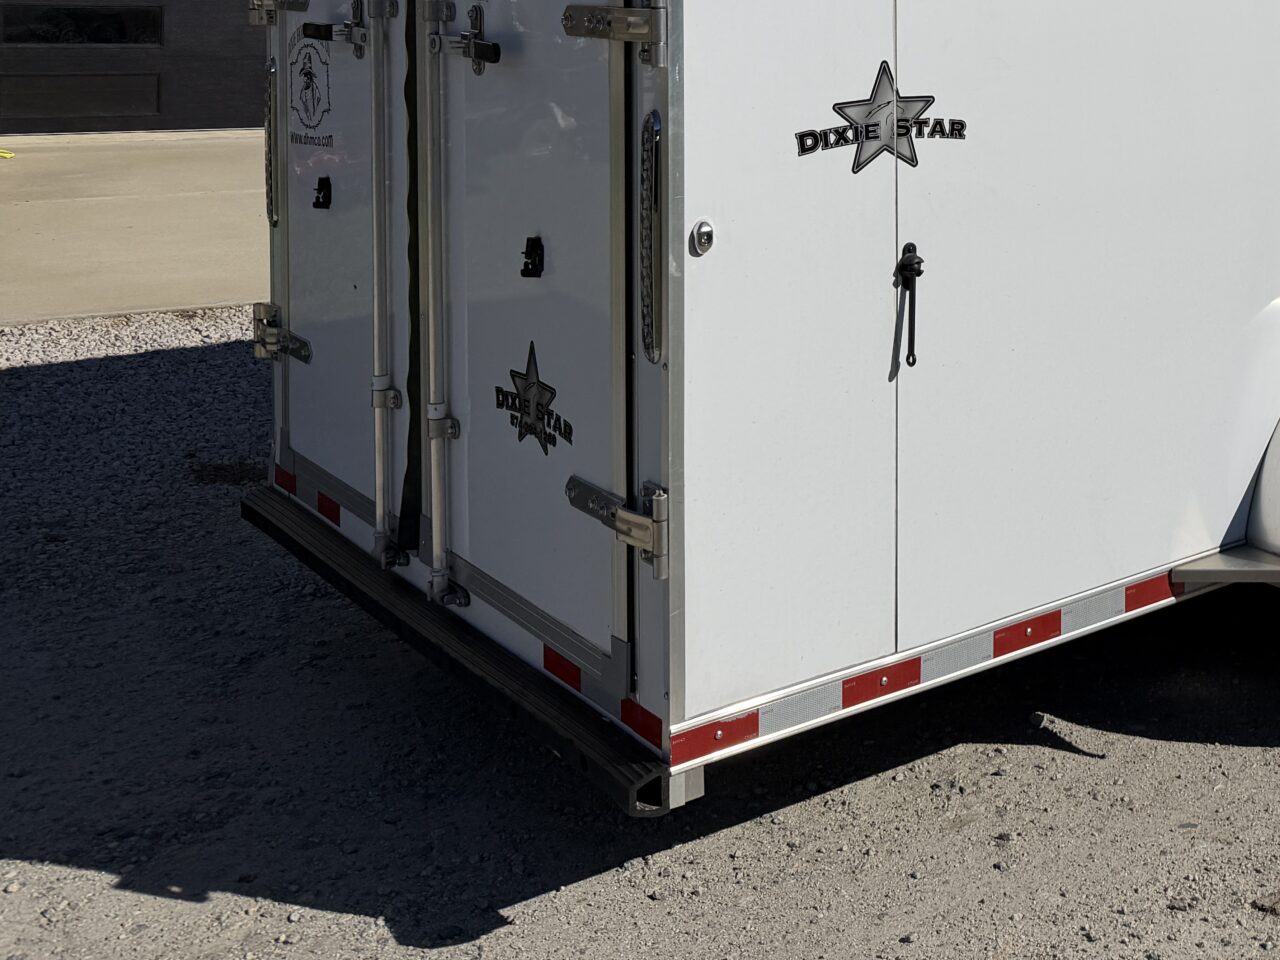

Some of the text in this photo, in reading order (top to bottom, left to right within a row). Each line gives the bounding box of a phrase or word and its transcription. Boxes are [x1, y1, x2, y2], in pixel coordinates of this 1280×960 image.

[795, 117, 967, 157] DIXIE STAR
[495, 386, 531, 416] DIXIE
[536, 403, 573, 446] STAR
